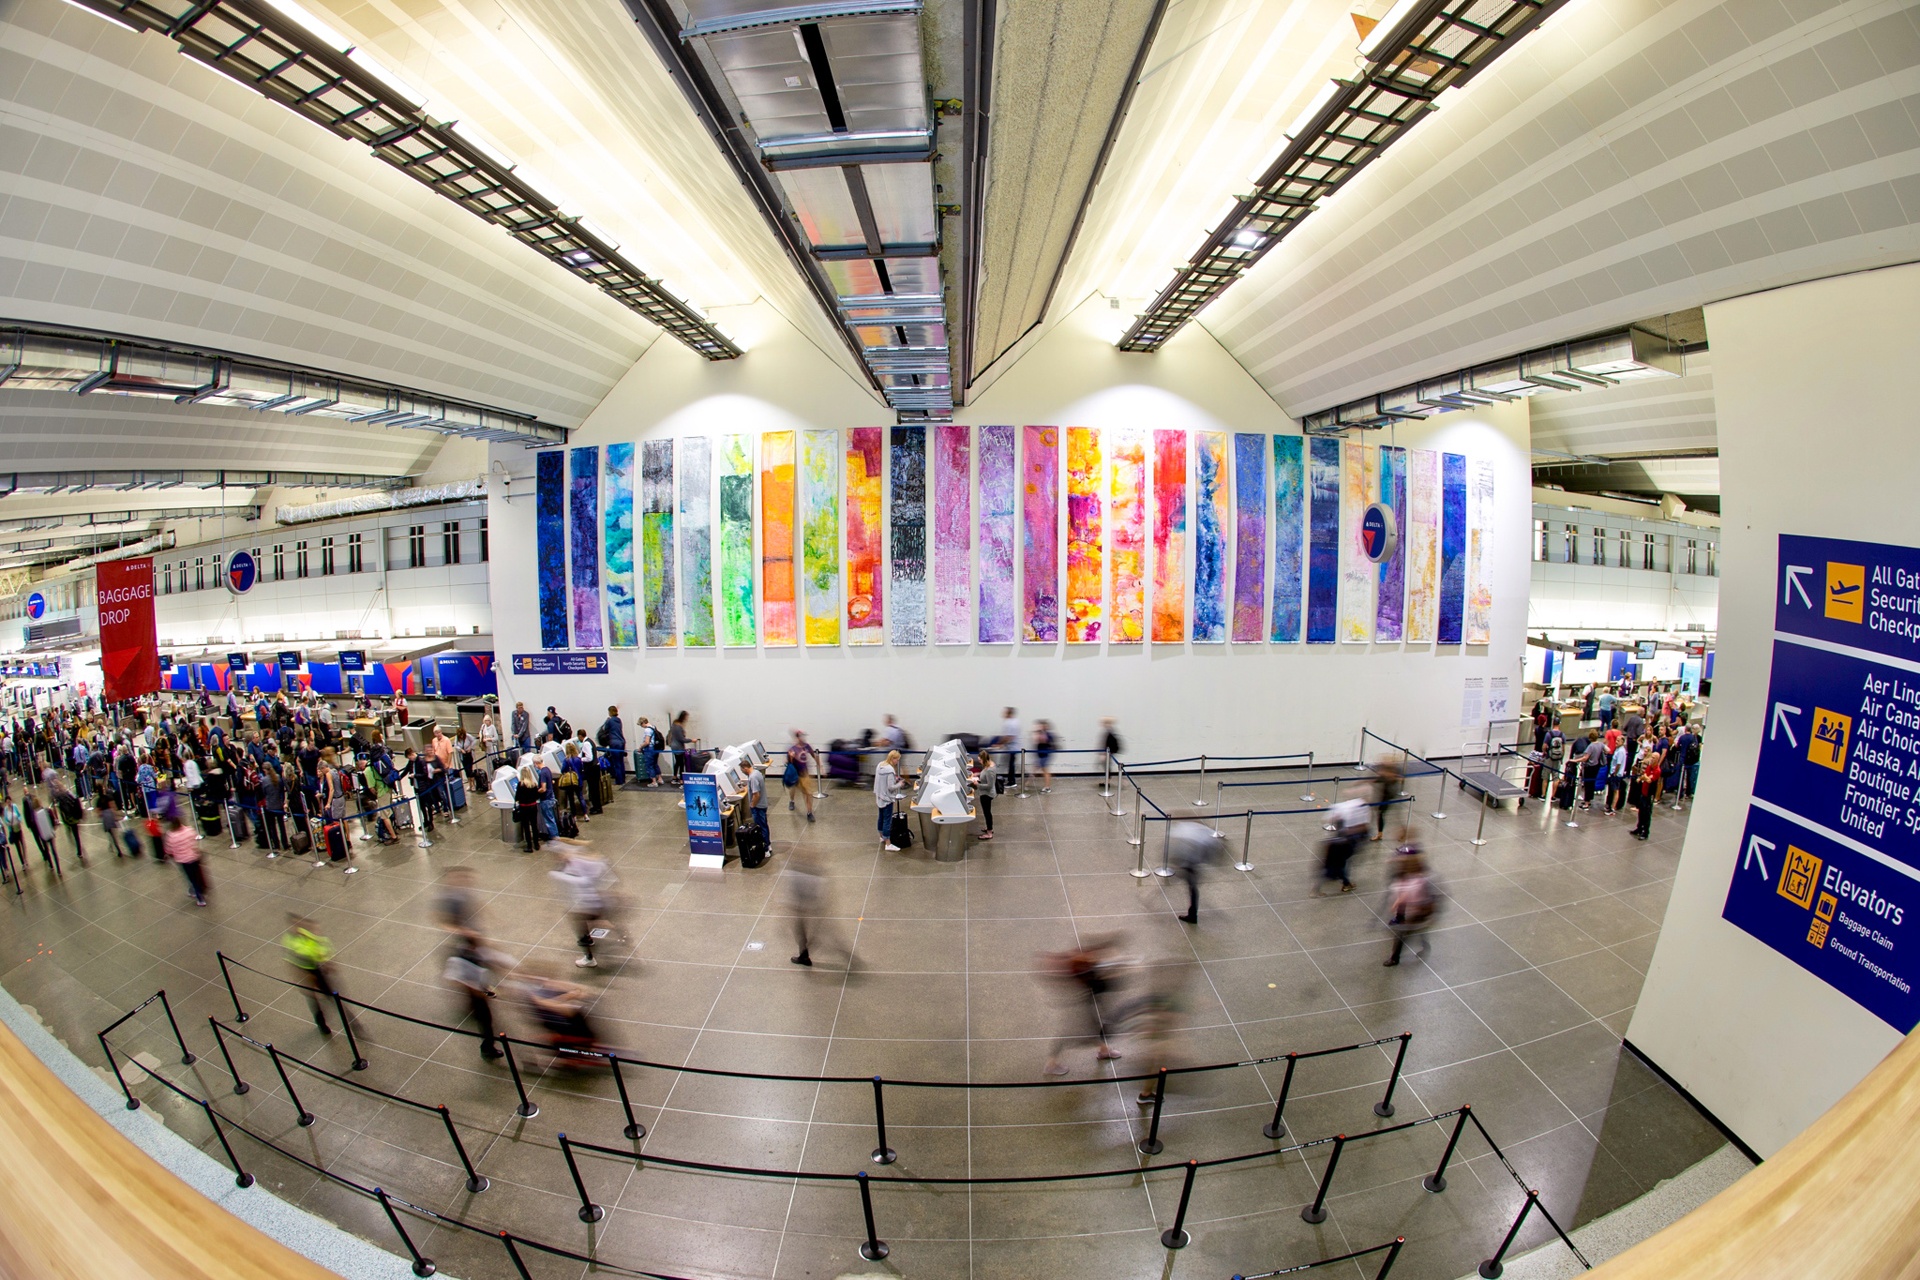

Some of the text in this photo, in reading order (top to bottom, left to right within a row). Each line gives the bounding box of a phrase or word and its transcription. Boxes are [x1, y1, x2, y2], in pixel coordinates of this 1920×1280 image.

[99, 584, 151, 605] BAGGAGE
[1871, 565, 1920, 590] All Gat
[100, 608, 131, 626] DROP
[1863, 673, 1890, 696] Aer
[1860, 696, 1920, 730] Air Cana
[1857, 718, 1920, 755] Air Choic
[1853, 740, 1903, 777] Alaska,
[1849, 761, 1910, 800] Boutique
[1840, 804, 1886, 839] United
[1844, 783, 1901, 826] Frontier,
[1823, 865, 1904, 926] Elevators
[1838, 911, 1894, 951] Baggage Claim
[1830, 937, 1911, 994] Ground Transportation
